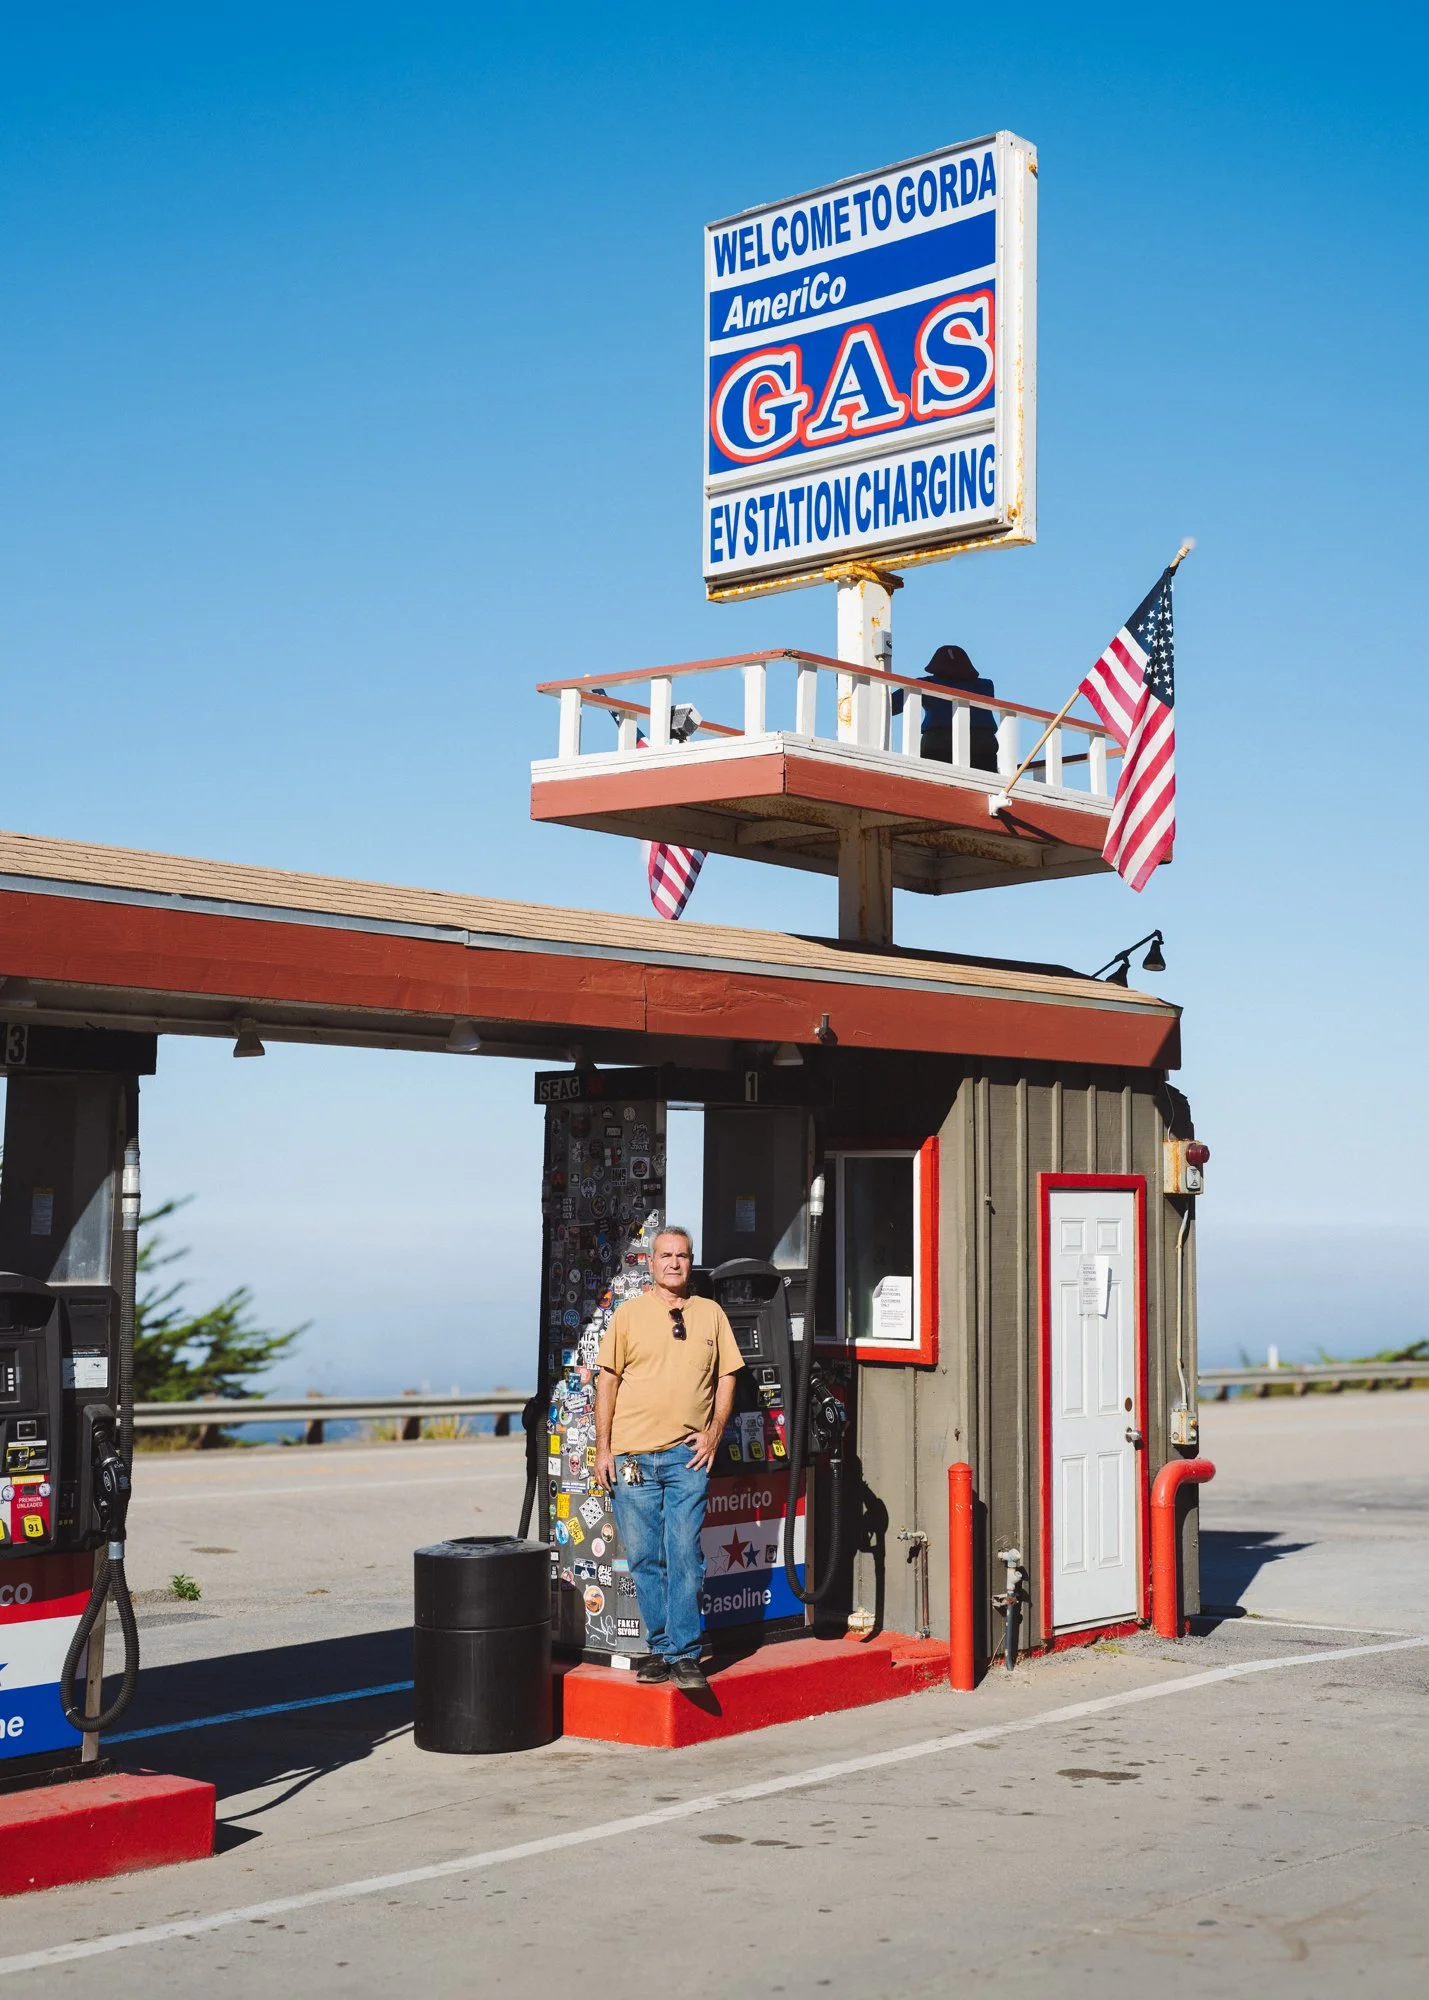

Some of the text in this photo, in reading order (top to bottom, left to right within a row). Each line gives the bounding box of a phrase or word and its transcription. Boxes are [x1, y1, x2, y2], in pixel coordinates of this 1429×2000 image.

[713, 151, 996, 277] WELCOME TO GORDA
[722, 271, 847, 333] AmeriCo
[711, 288, 996, 464] GAS
[710, 444, 995, 564] EV STATION CHARGING
[9, 1025, 26, 1063] 3
[541, 1078, 579, 1100] SEAG
[748, 1073, 756, 1100] 1
[28, 1524, 39, 1532] 91
[701, 1587, 772, 1616] Gasoline
[617, 1619, 640, 1629] FAKEY
